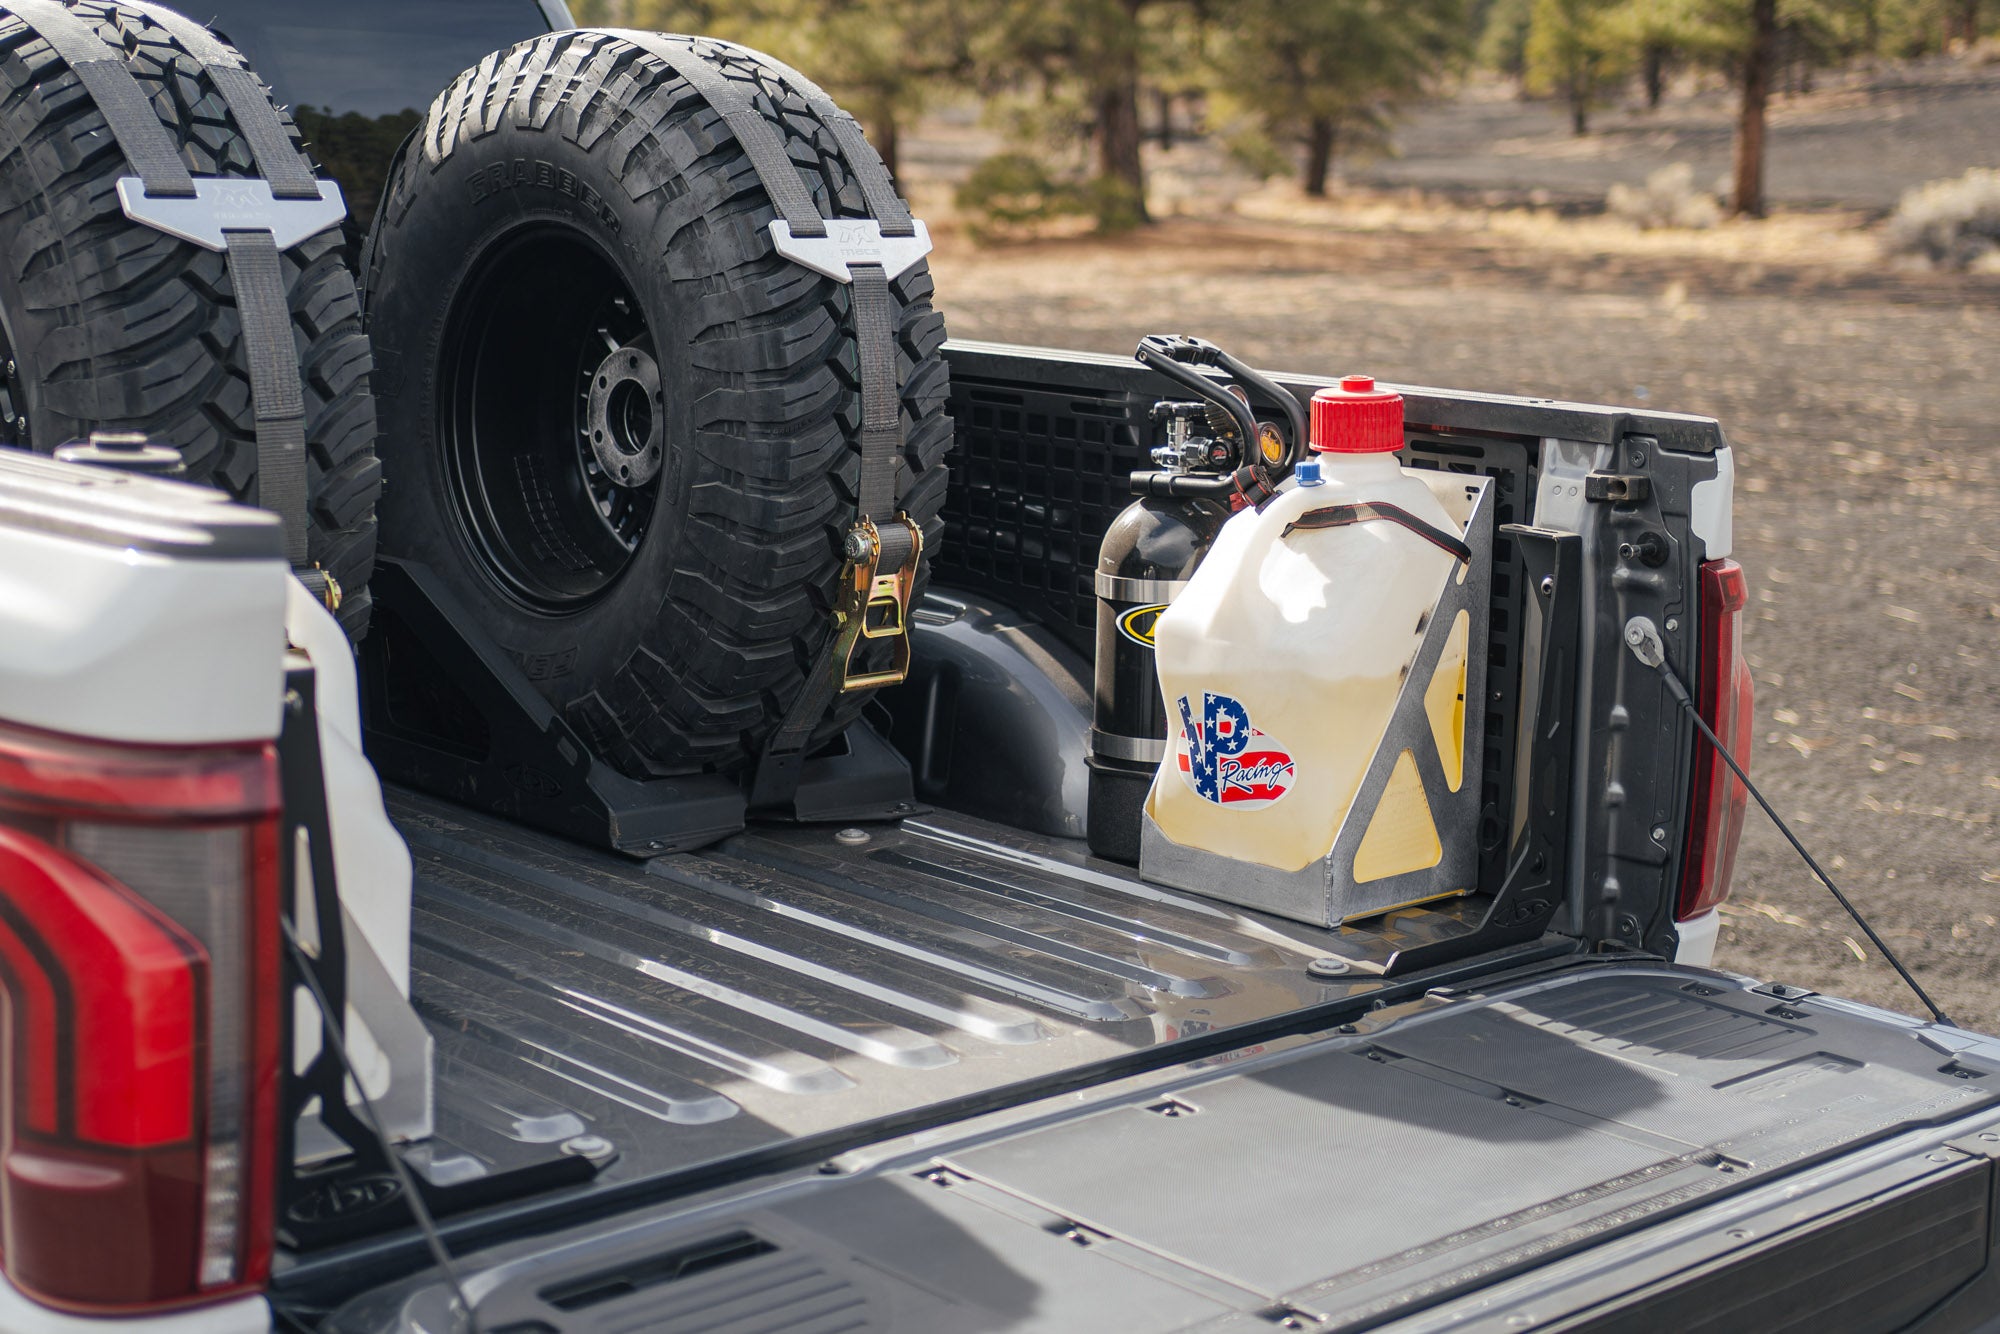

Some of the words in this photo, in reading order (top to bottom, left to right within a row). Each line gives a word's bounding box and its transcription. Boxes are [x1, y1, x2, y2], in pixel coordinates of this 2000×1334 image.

[465, 158, 622, 236] GRABBER
[1176, 691, 1251, 804] VP
[1221, 757, 1296, 794] Racing
